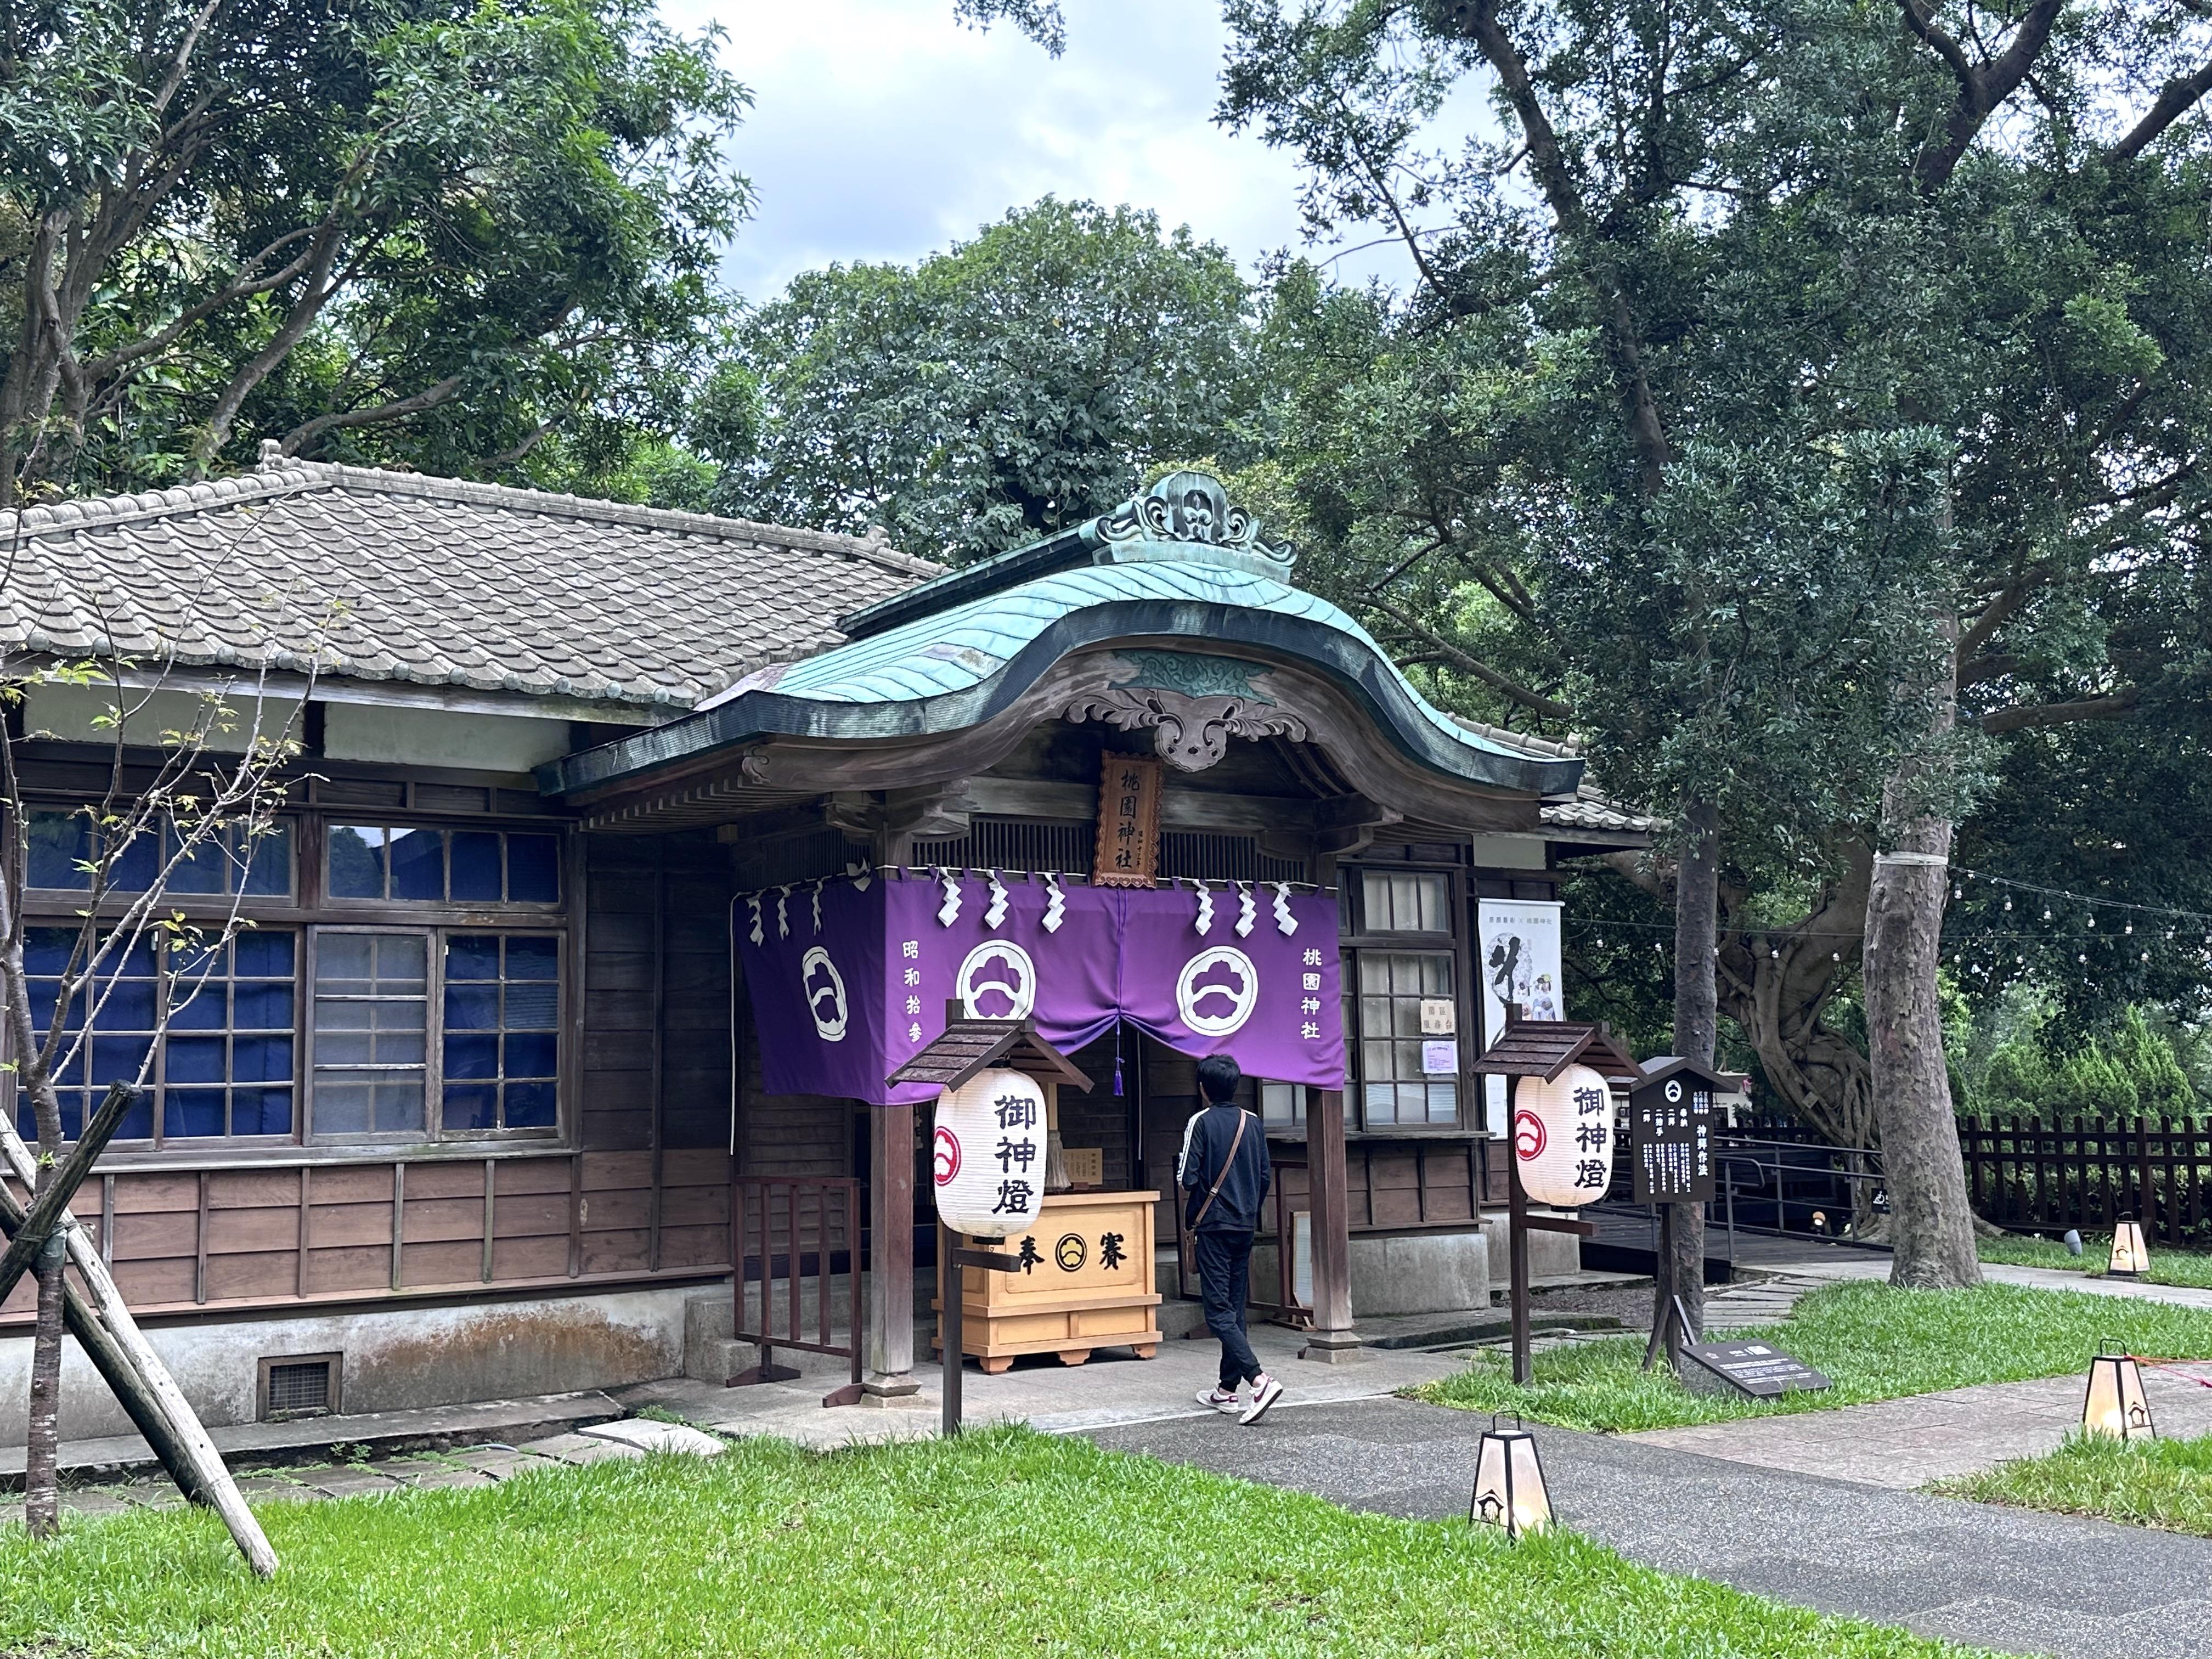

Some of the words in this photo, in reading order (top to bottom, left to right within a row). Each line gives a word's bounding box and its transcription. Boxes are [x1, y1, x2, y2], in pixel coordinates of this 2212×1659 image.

[1115, 769, 1139, 870] 桃園神社
[1301, 948, 1322, 1040] 桃園神社
[991, 1095, 1036, 1214] 御神燈
[1573, 1086, 1607, 1188] 御神燈
[1019, 1235, 1045, 1275] 奉
[1099, 1232, 1128, 1271] 賽
